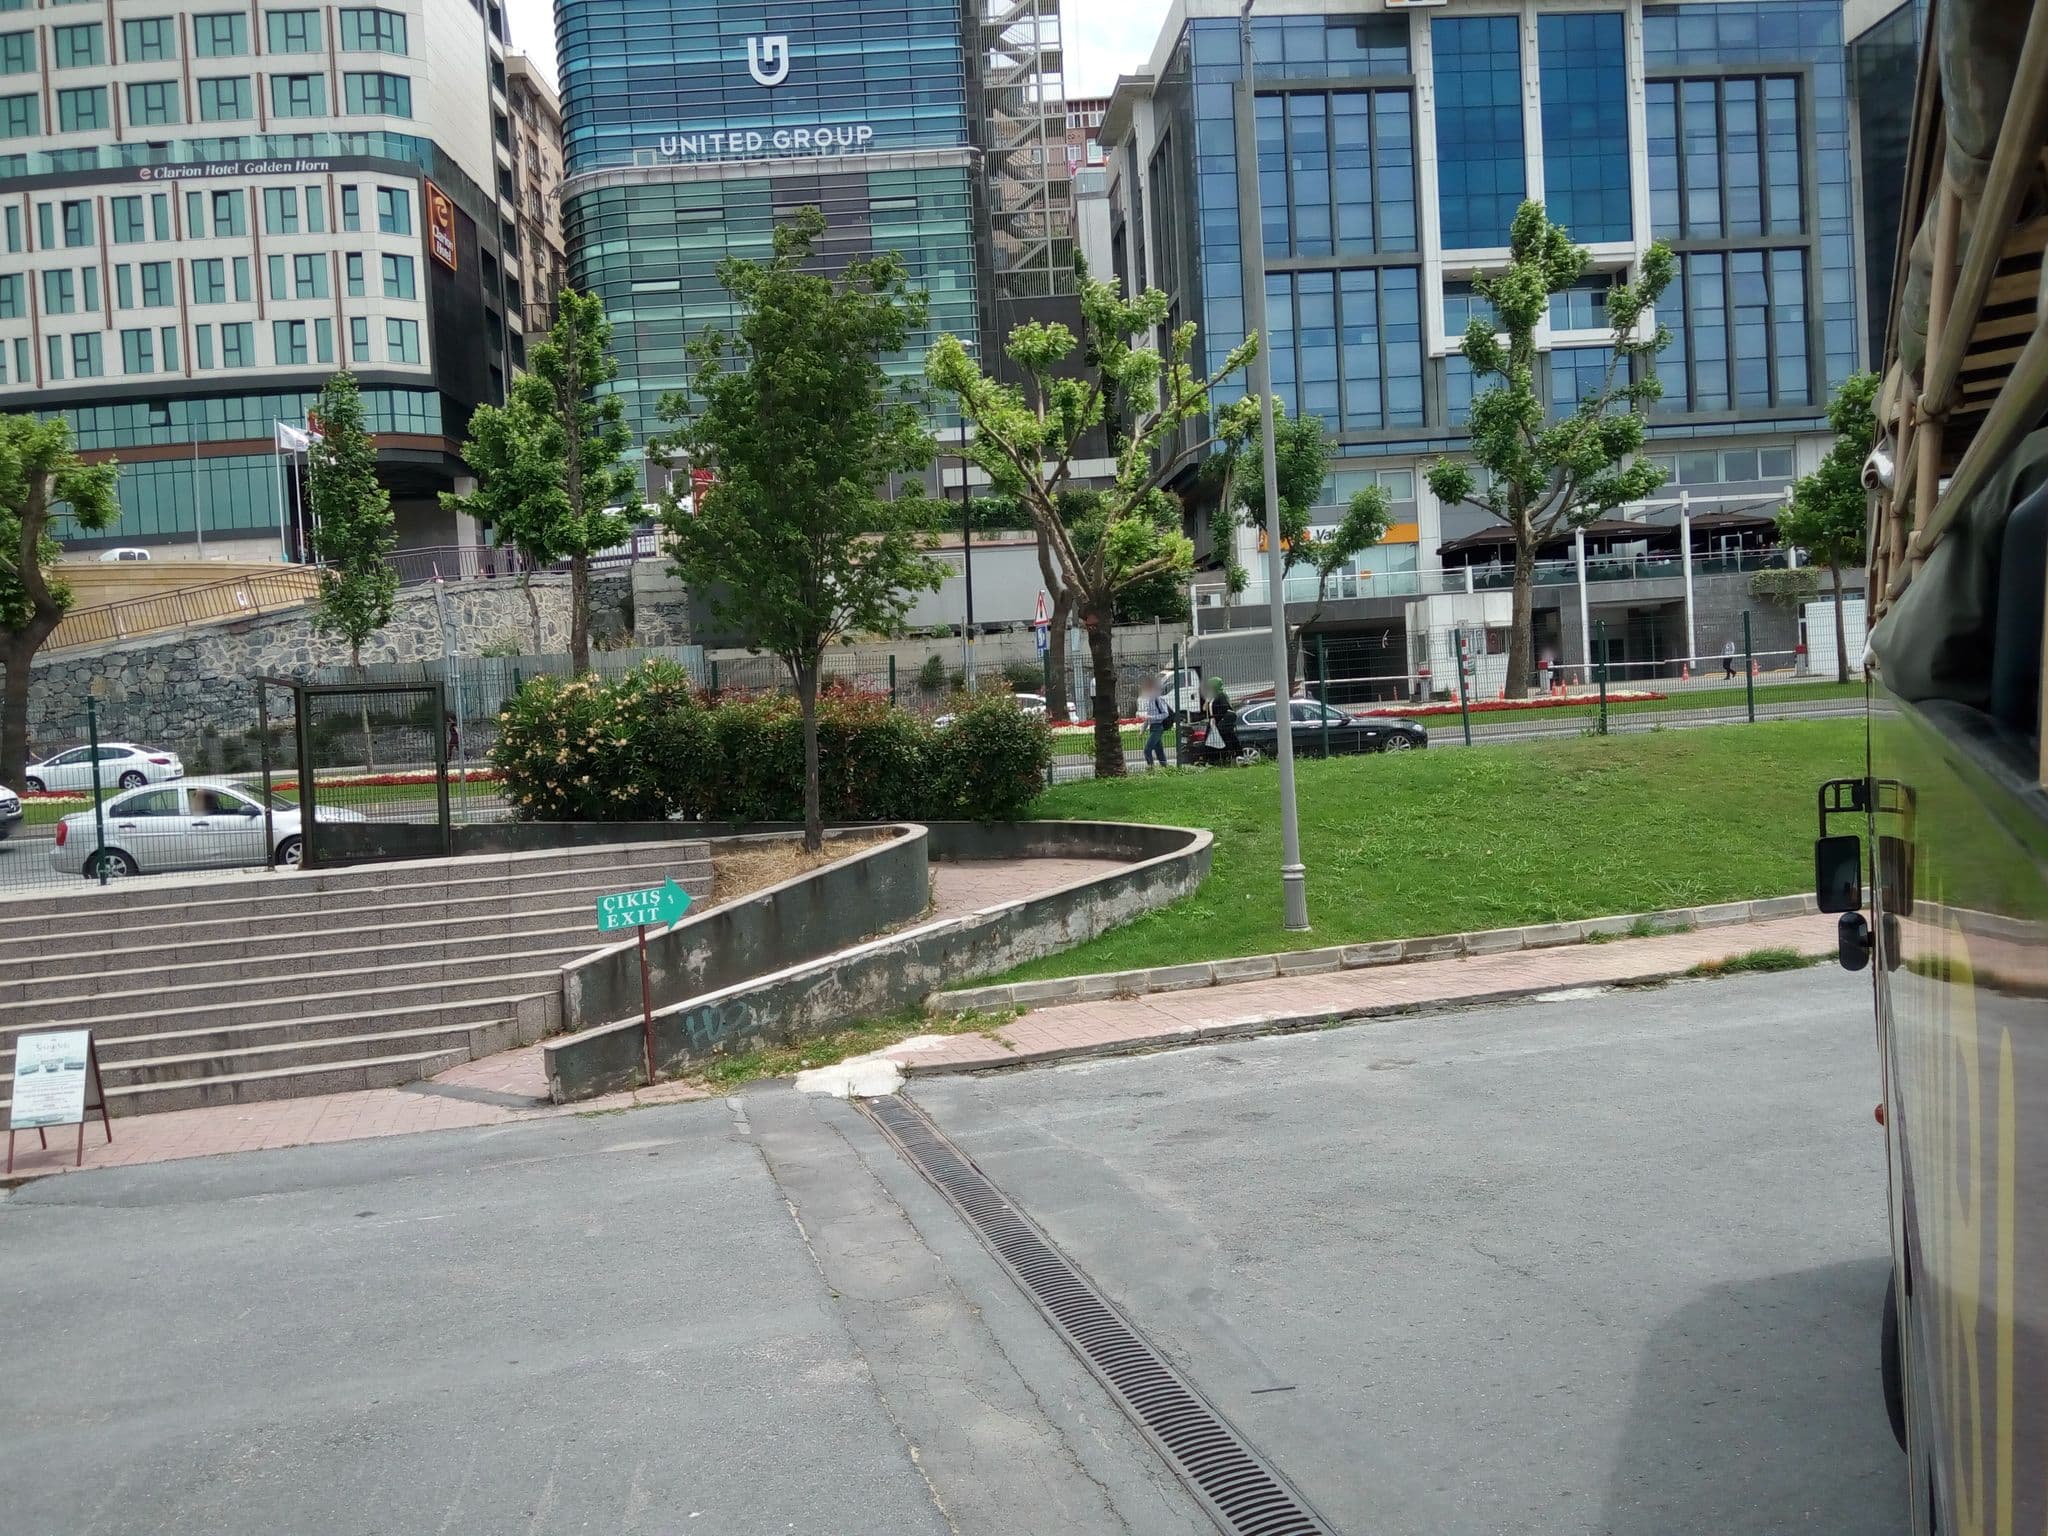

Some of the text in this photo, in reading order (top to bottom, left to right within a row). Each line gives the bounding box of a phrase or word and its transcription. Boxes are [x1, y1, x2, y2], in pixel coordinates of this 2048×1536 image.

[660, 125, 873, 156] UNITED GROUP
[154, 160, 329, 179] Clarion Hotel Golden Horn
[603, 890, 661, 914] ÇIKIŞ
[607, 907, 660, 929] EXIT
